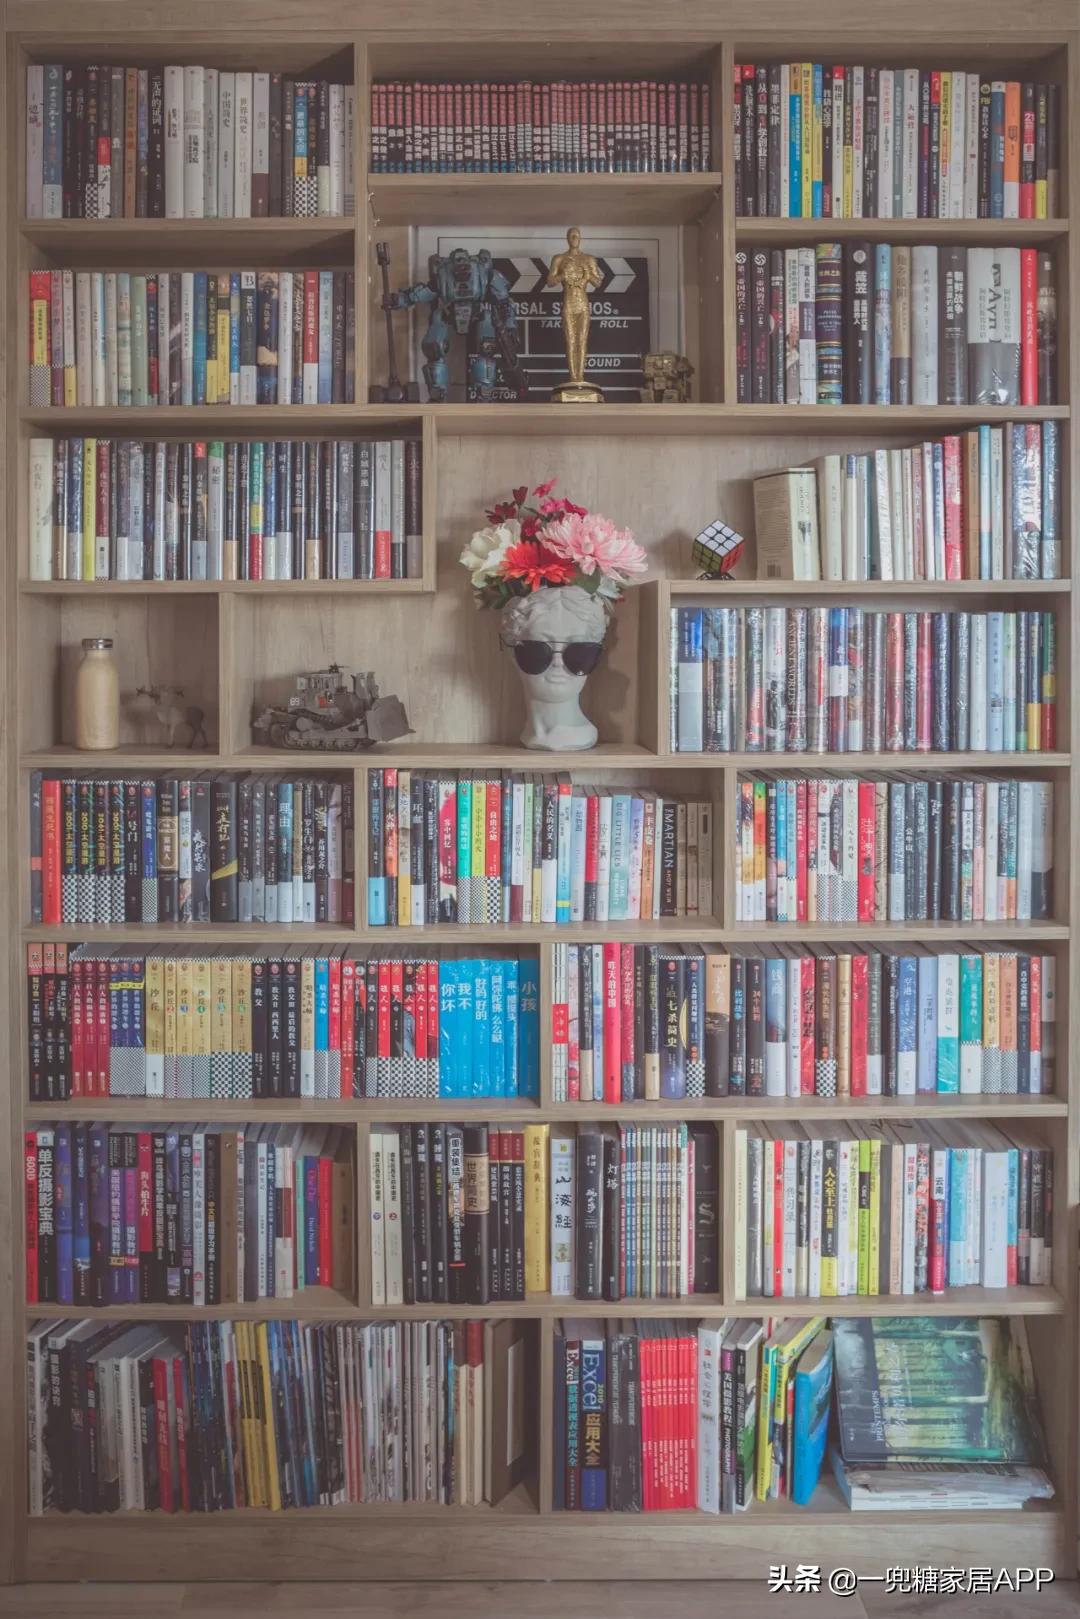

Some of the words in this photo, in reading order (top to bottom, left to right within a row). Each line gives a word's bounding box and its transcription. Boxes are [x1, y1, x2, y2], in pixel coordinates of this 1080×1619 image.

[222, 91, 231, 128] 中国简史
[239, 96, 249, 134] 世界简史
[599, 319, 629, 329] ROLL
[546, 800, 554, 840] 人民的名义
[664, 812, 674, 868] MARTIAN
[254, 987, 263, 1007] 教父
[441, 983, 456, 1013] 你坏
[457, 983, 472, 1010] 我不
[521, 982, 537, 1013] 小孩
[271, 1011, 279, 1040] 西西里人
[288, 1011, 296, 1047] 最后的教父
[667, 1000, 678, 1047] 七杀简史
[38, 1148, 54, 1237] 单反摄影宝典
[607, 1163, 618, 1190] 灯塔
[555, 1175, 572, 1229] 山海经
[566, 1348, 580, 1385] Excel
[582, 1353, 602, 1411] Excel
[585, 1413, 601, 1466] 应用大全
